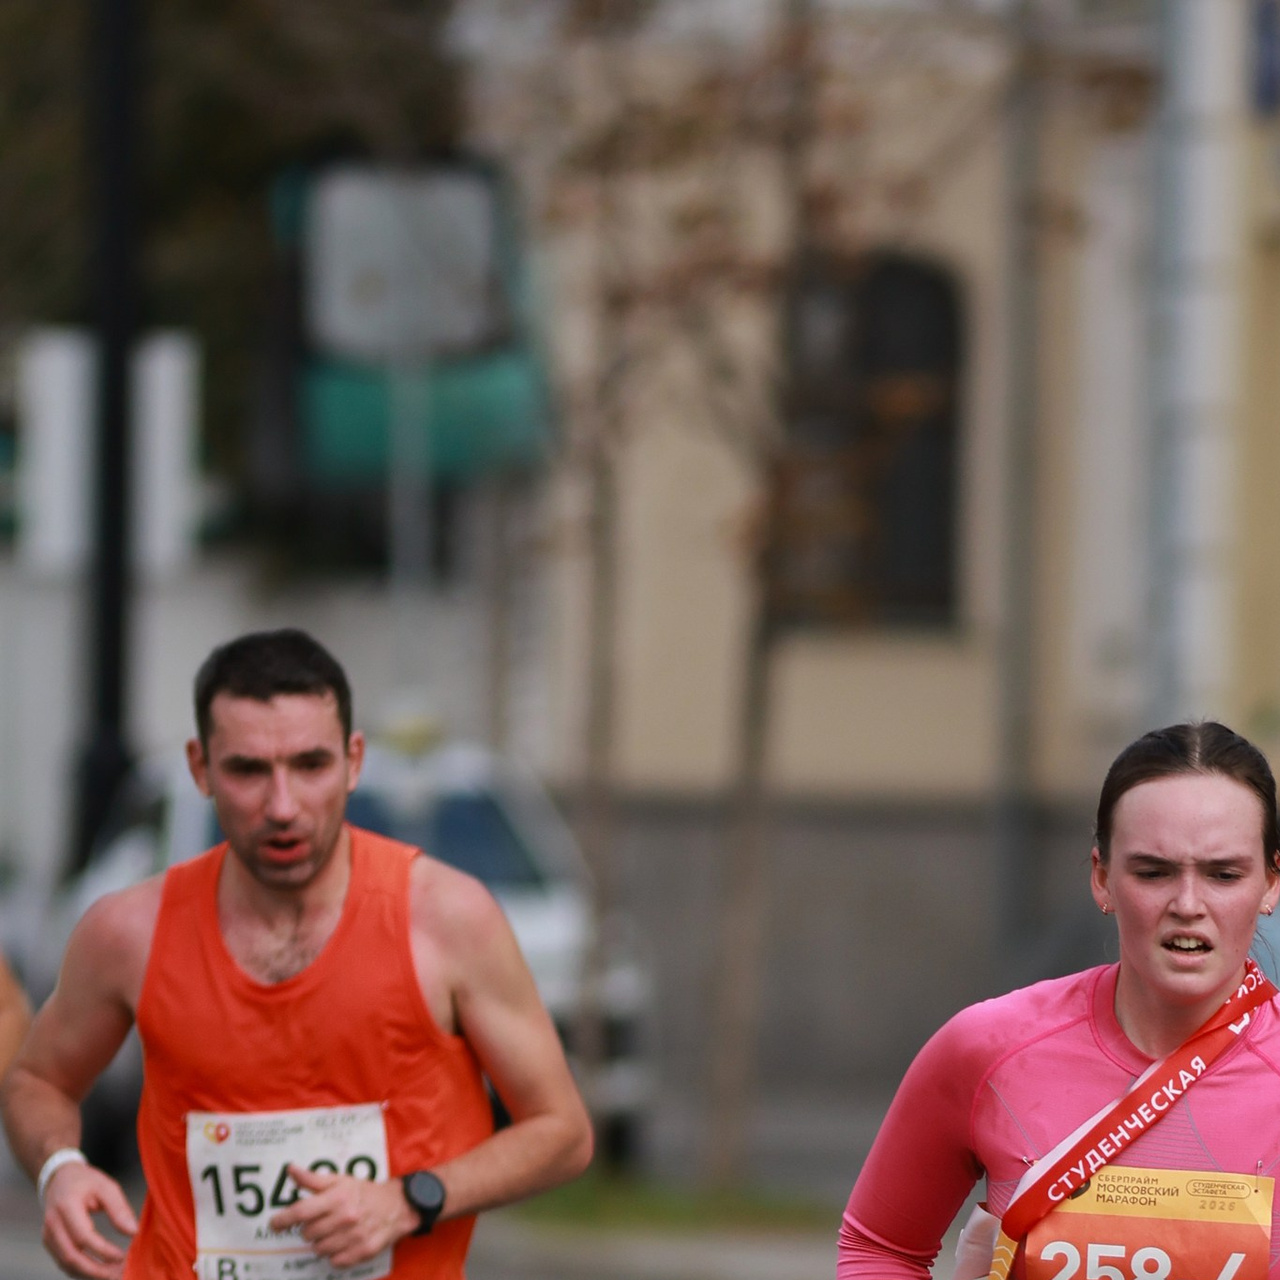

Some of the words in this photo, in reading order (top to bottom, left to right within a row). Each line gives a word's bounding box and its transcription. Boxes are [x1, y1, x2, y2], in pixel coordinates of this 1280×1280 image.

[1047, 1055, 1207, 1201] СТУДЕНЧЕСКАЯ
[1097, 1173, 1159, 1185] СБЕРПРАЙМ
[1096, 1182, 1180, 1197] МОСКОВСКИЙ
[1192, 1182, 1246, 1191] СТУДЕНЧЕСКАЯ
[1095, 1193, 1157, 1207] МАРАФОН
